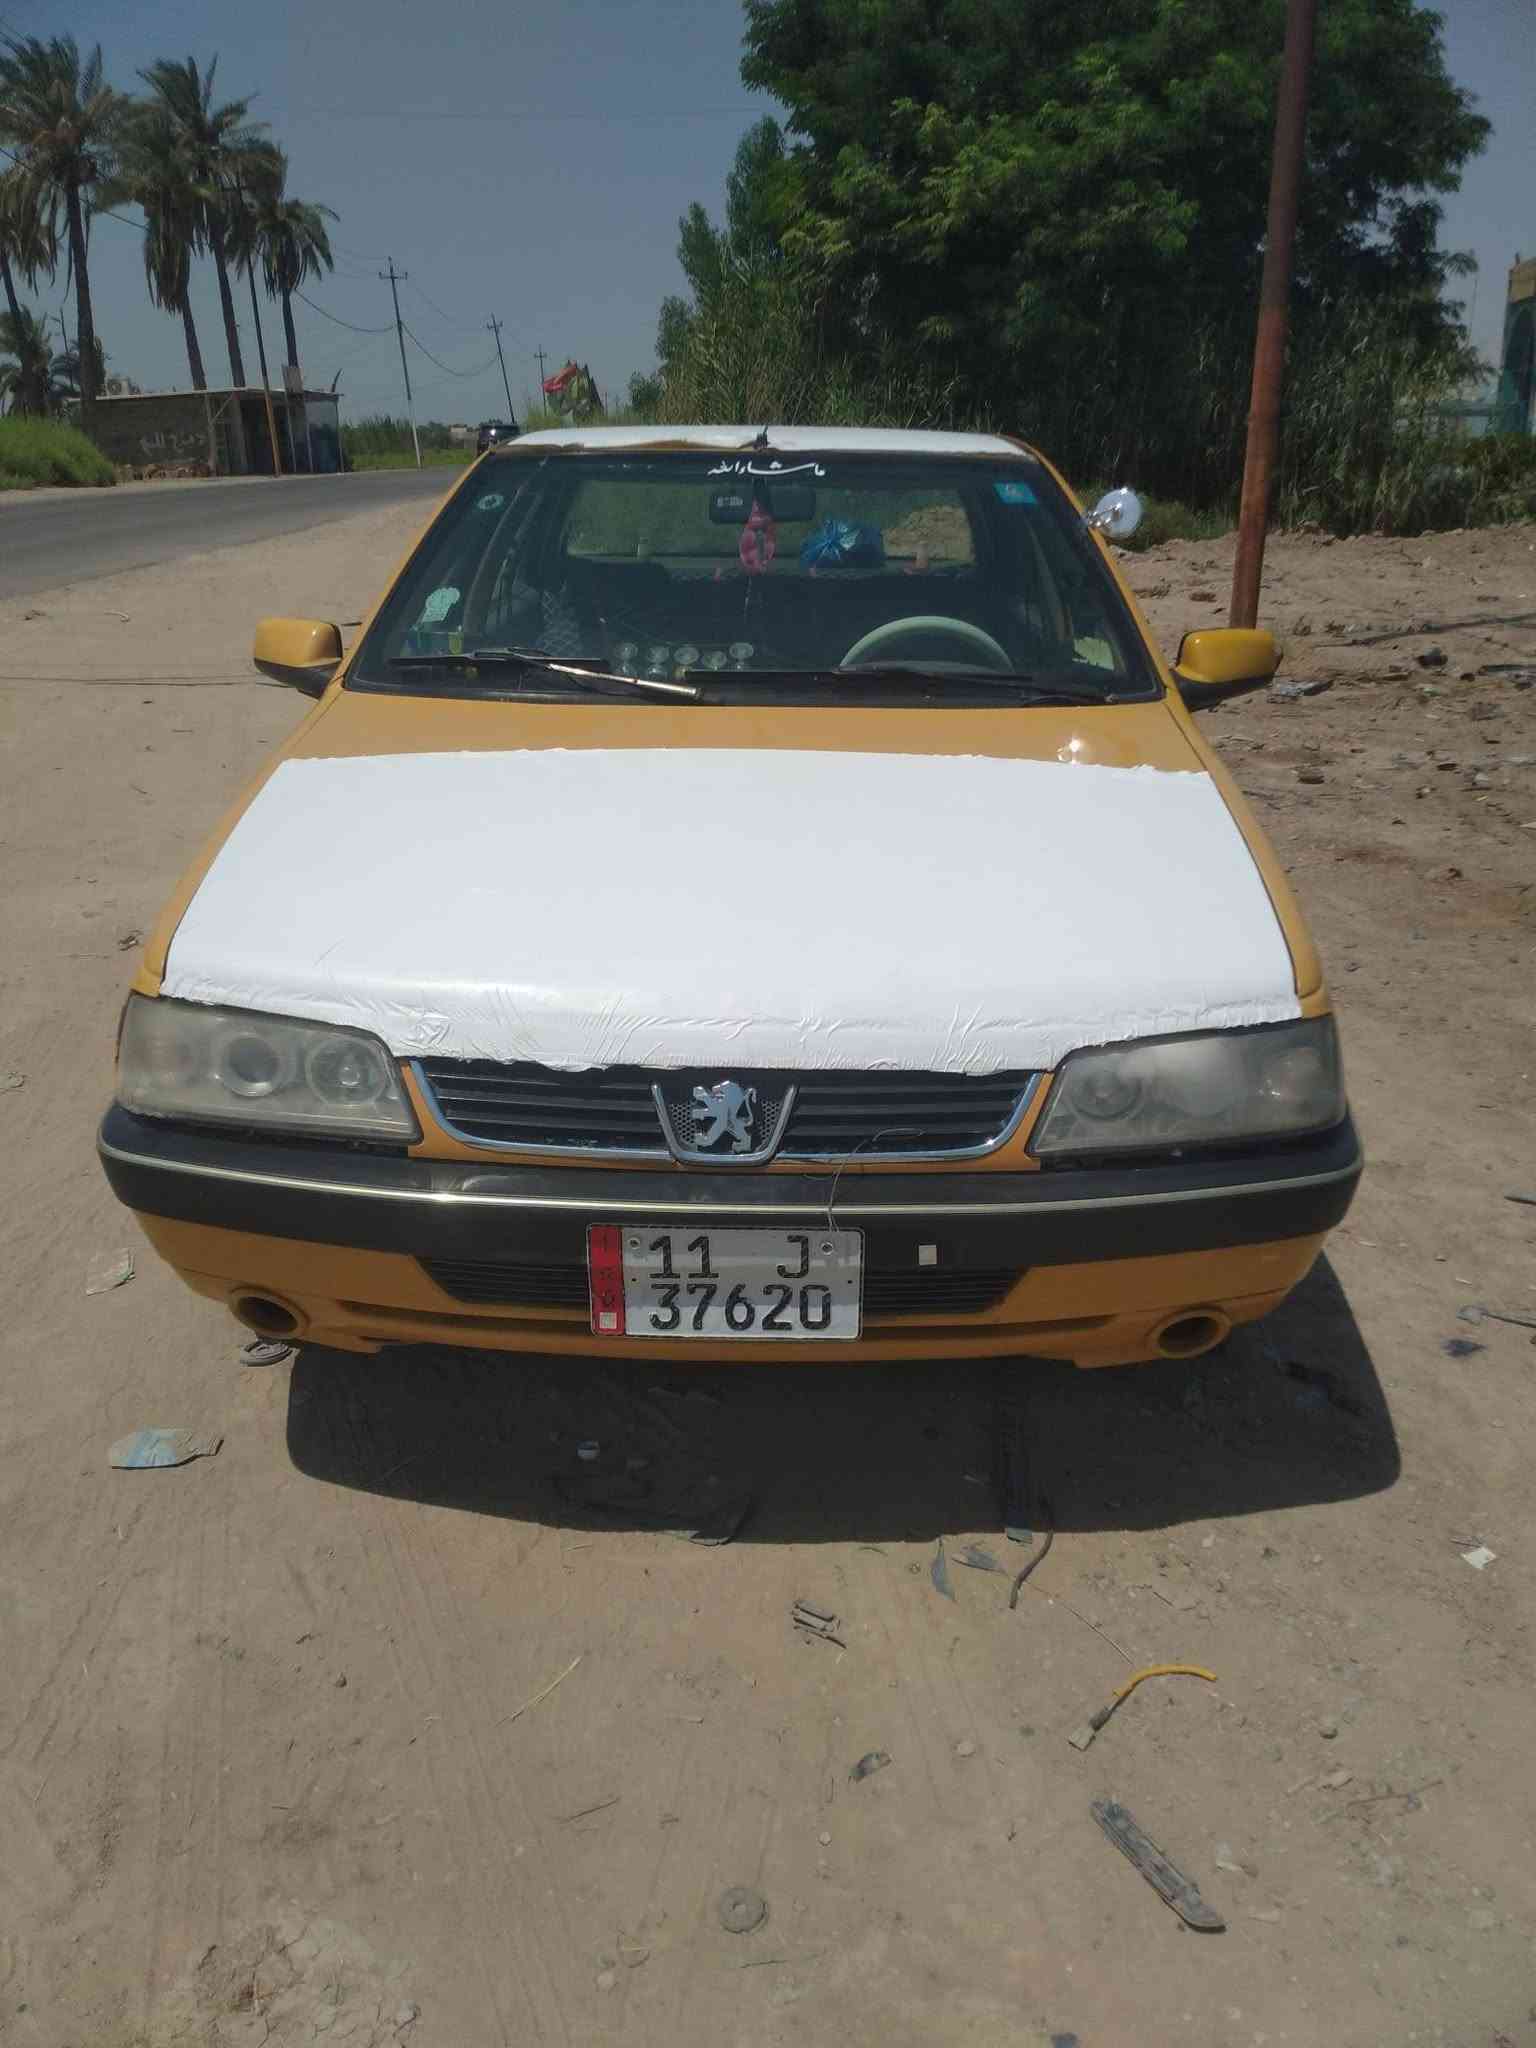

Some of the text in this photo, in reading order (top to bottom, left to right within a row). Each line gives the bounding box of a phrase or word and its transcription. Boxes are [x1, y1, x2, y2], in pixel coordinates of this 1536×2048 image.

[649, 1234, 809, 1279] 11 J
[649, 1283, 832, 1331] 37620
